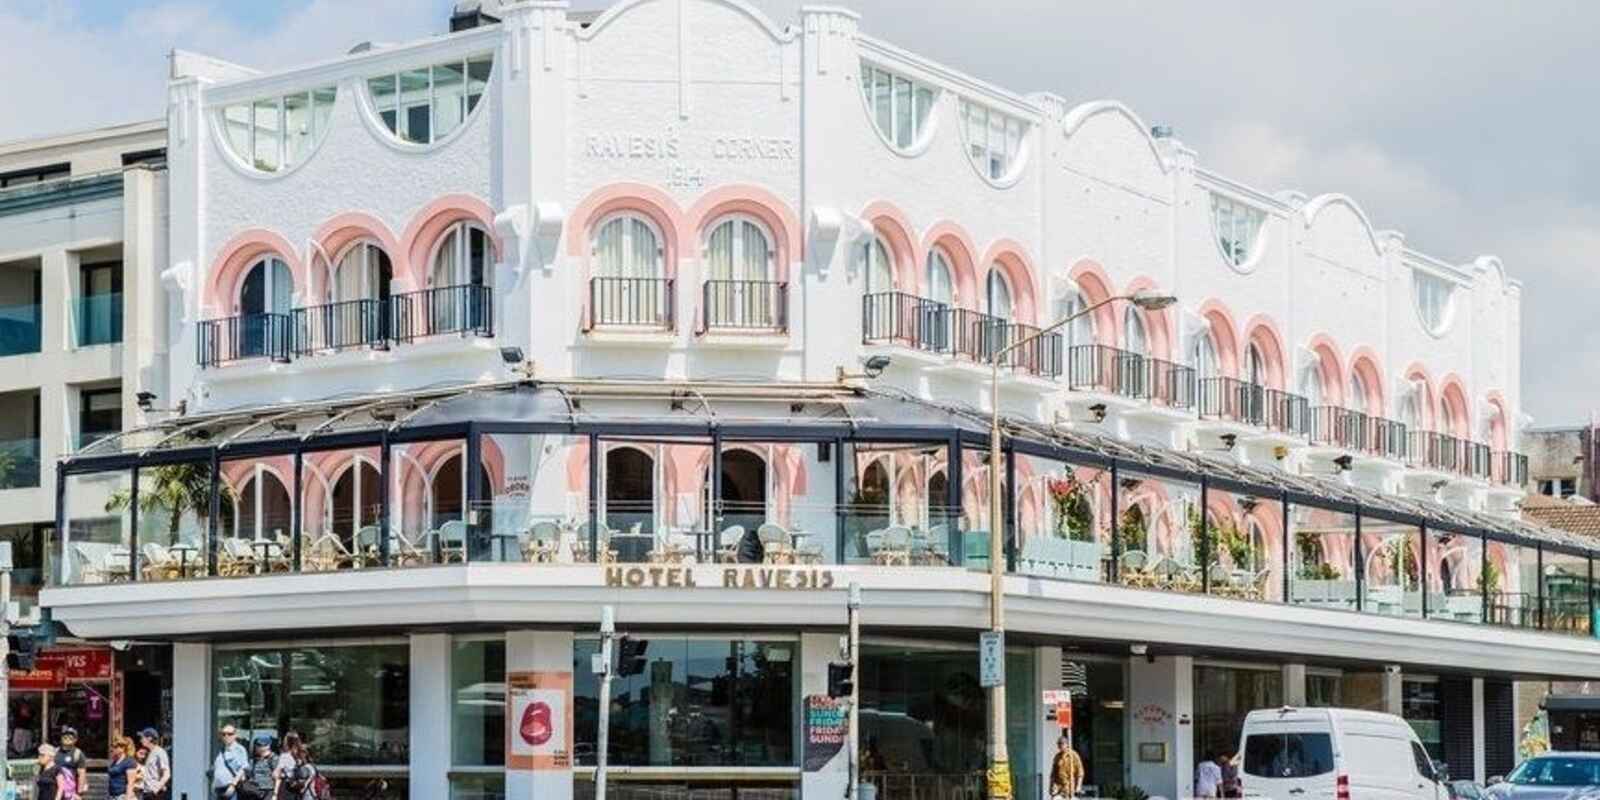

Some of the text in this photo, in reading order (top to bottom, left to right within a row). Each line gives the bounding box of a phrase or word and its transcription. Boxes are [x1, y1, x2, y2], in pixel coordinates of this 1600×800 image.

[711, 138, 795, 161] CORNER
[605, 567, 835, 590] HOTEL RAVESIS
